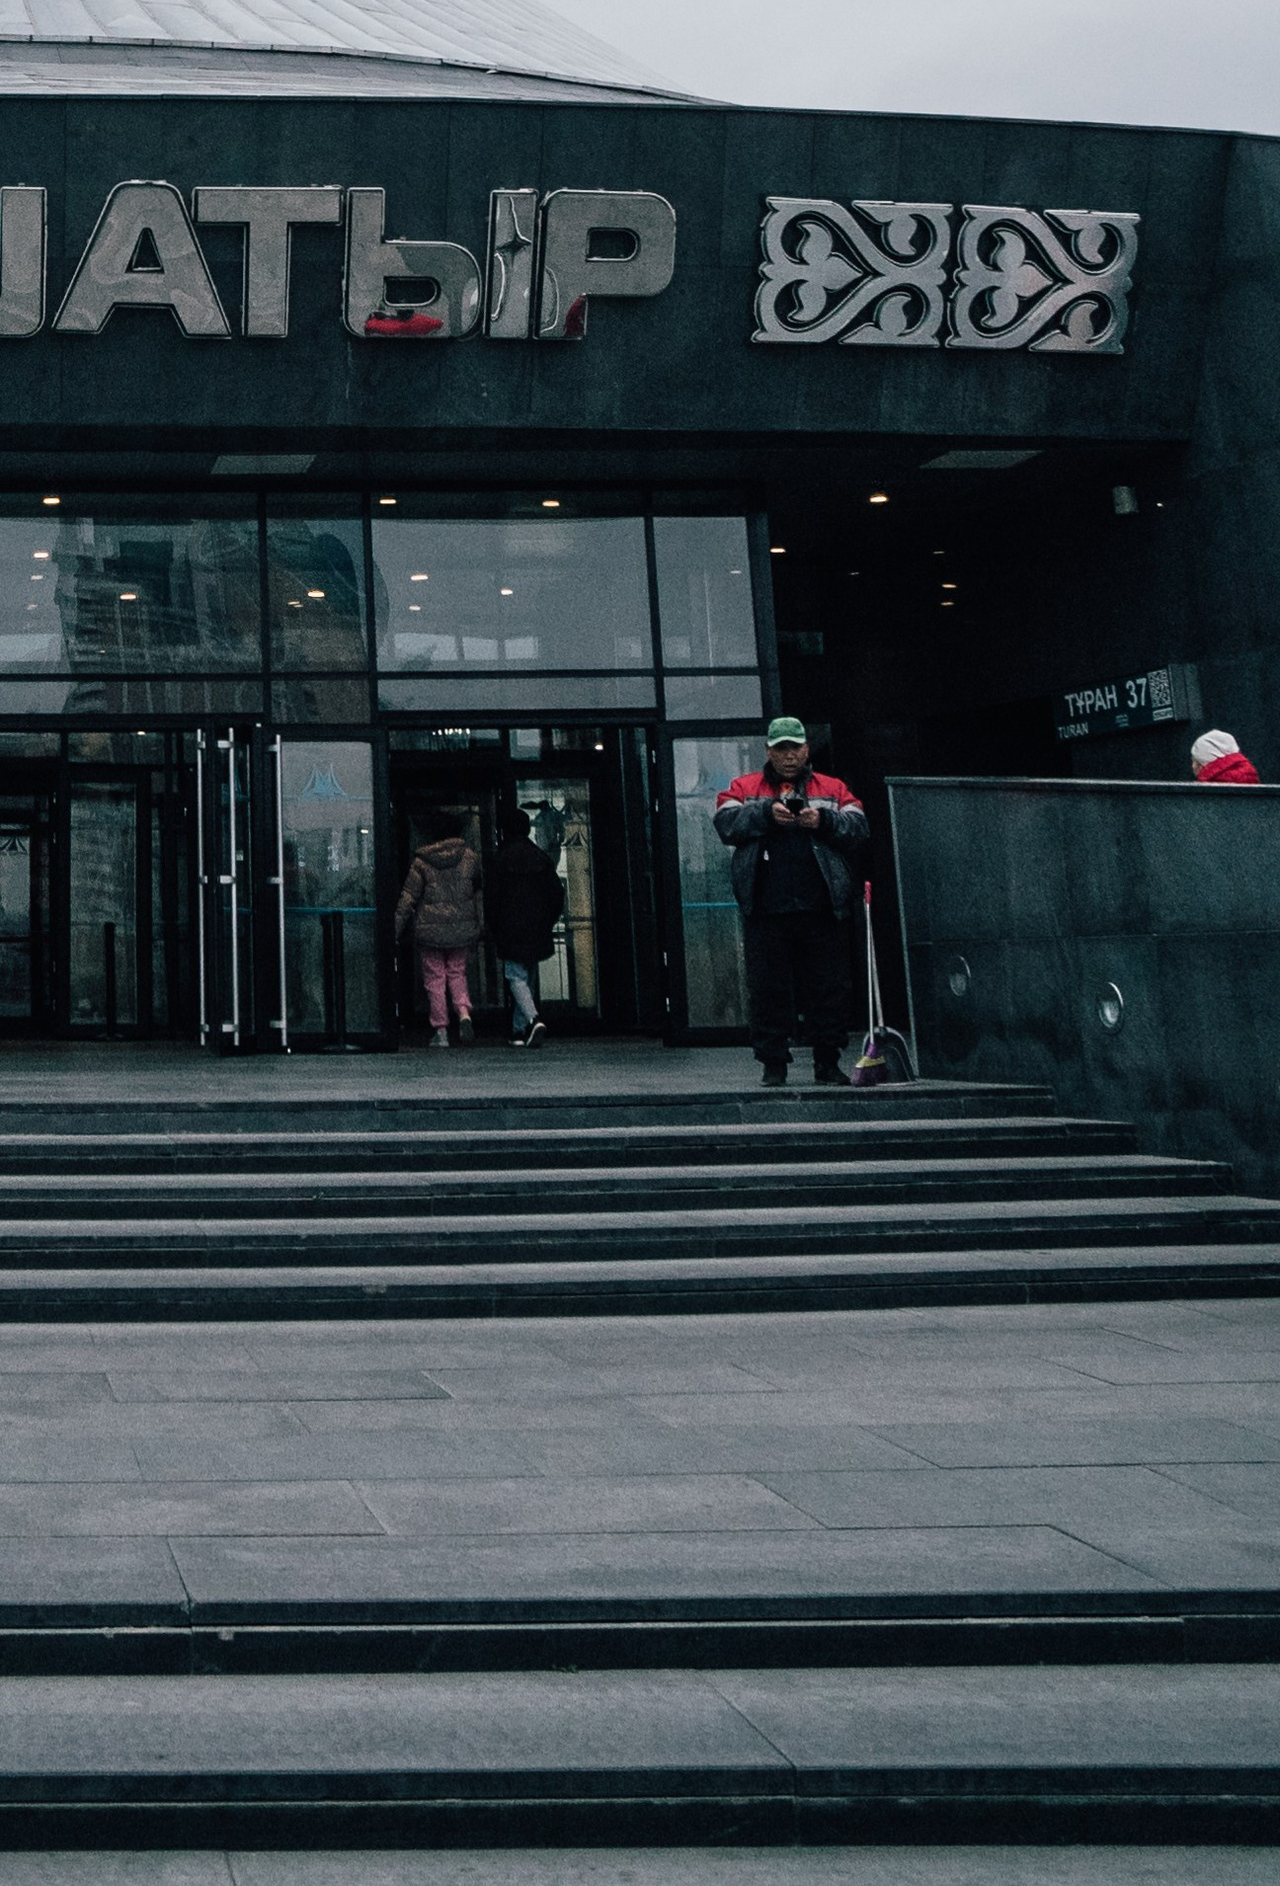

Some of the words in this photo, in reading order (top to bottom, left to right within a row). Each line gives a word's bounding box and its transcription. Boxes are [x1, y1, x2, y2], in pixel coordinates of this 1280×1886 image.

[1064, 684, 1118, 717] ТҰРАН
[1125, 677, 1147, 708] 37
[1058, 722, 1089, 739] TURAN
